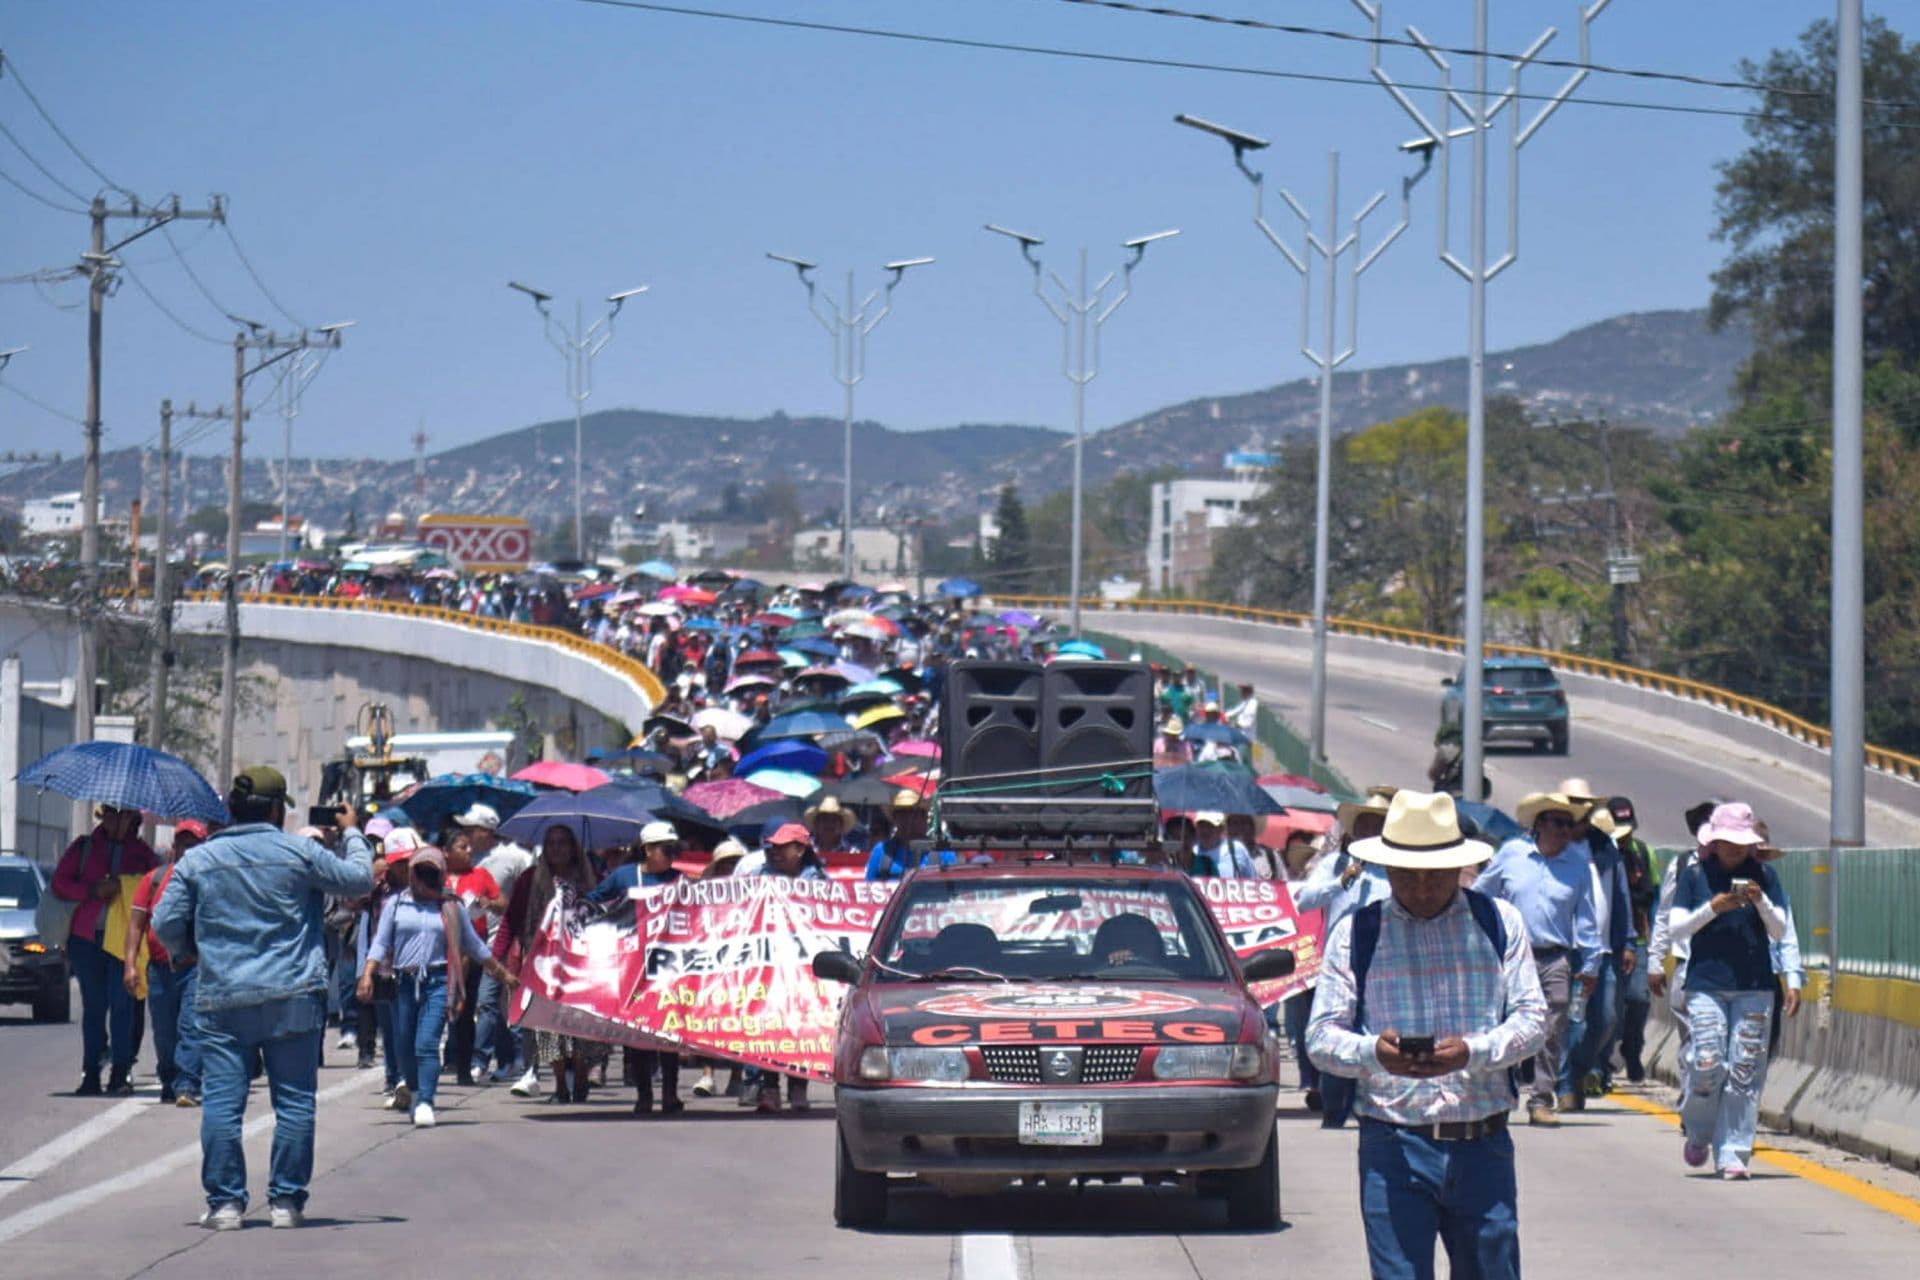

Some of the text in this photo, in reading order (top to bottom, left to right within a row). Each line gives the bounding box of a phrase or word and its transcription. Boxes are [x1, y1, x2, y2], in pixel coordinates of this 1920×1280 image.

[426, 529, 526, 560] OXXO
[645, 876, 849, 913] COORDINADORA
[646, 912, 689, 937] DE
[699, 1034, 832, 1054] rement
[911, 1020, 1227, 1045] CETEG
